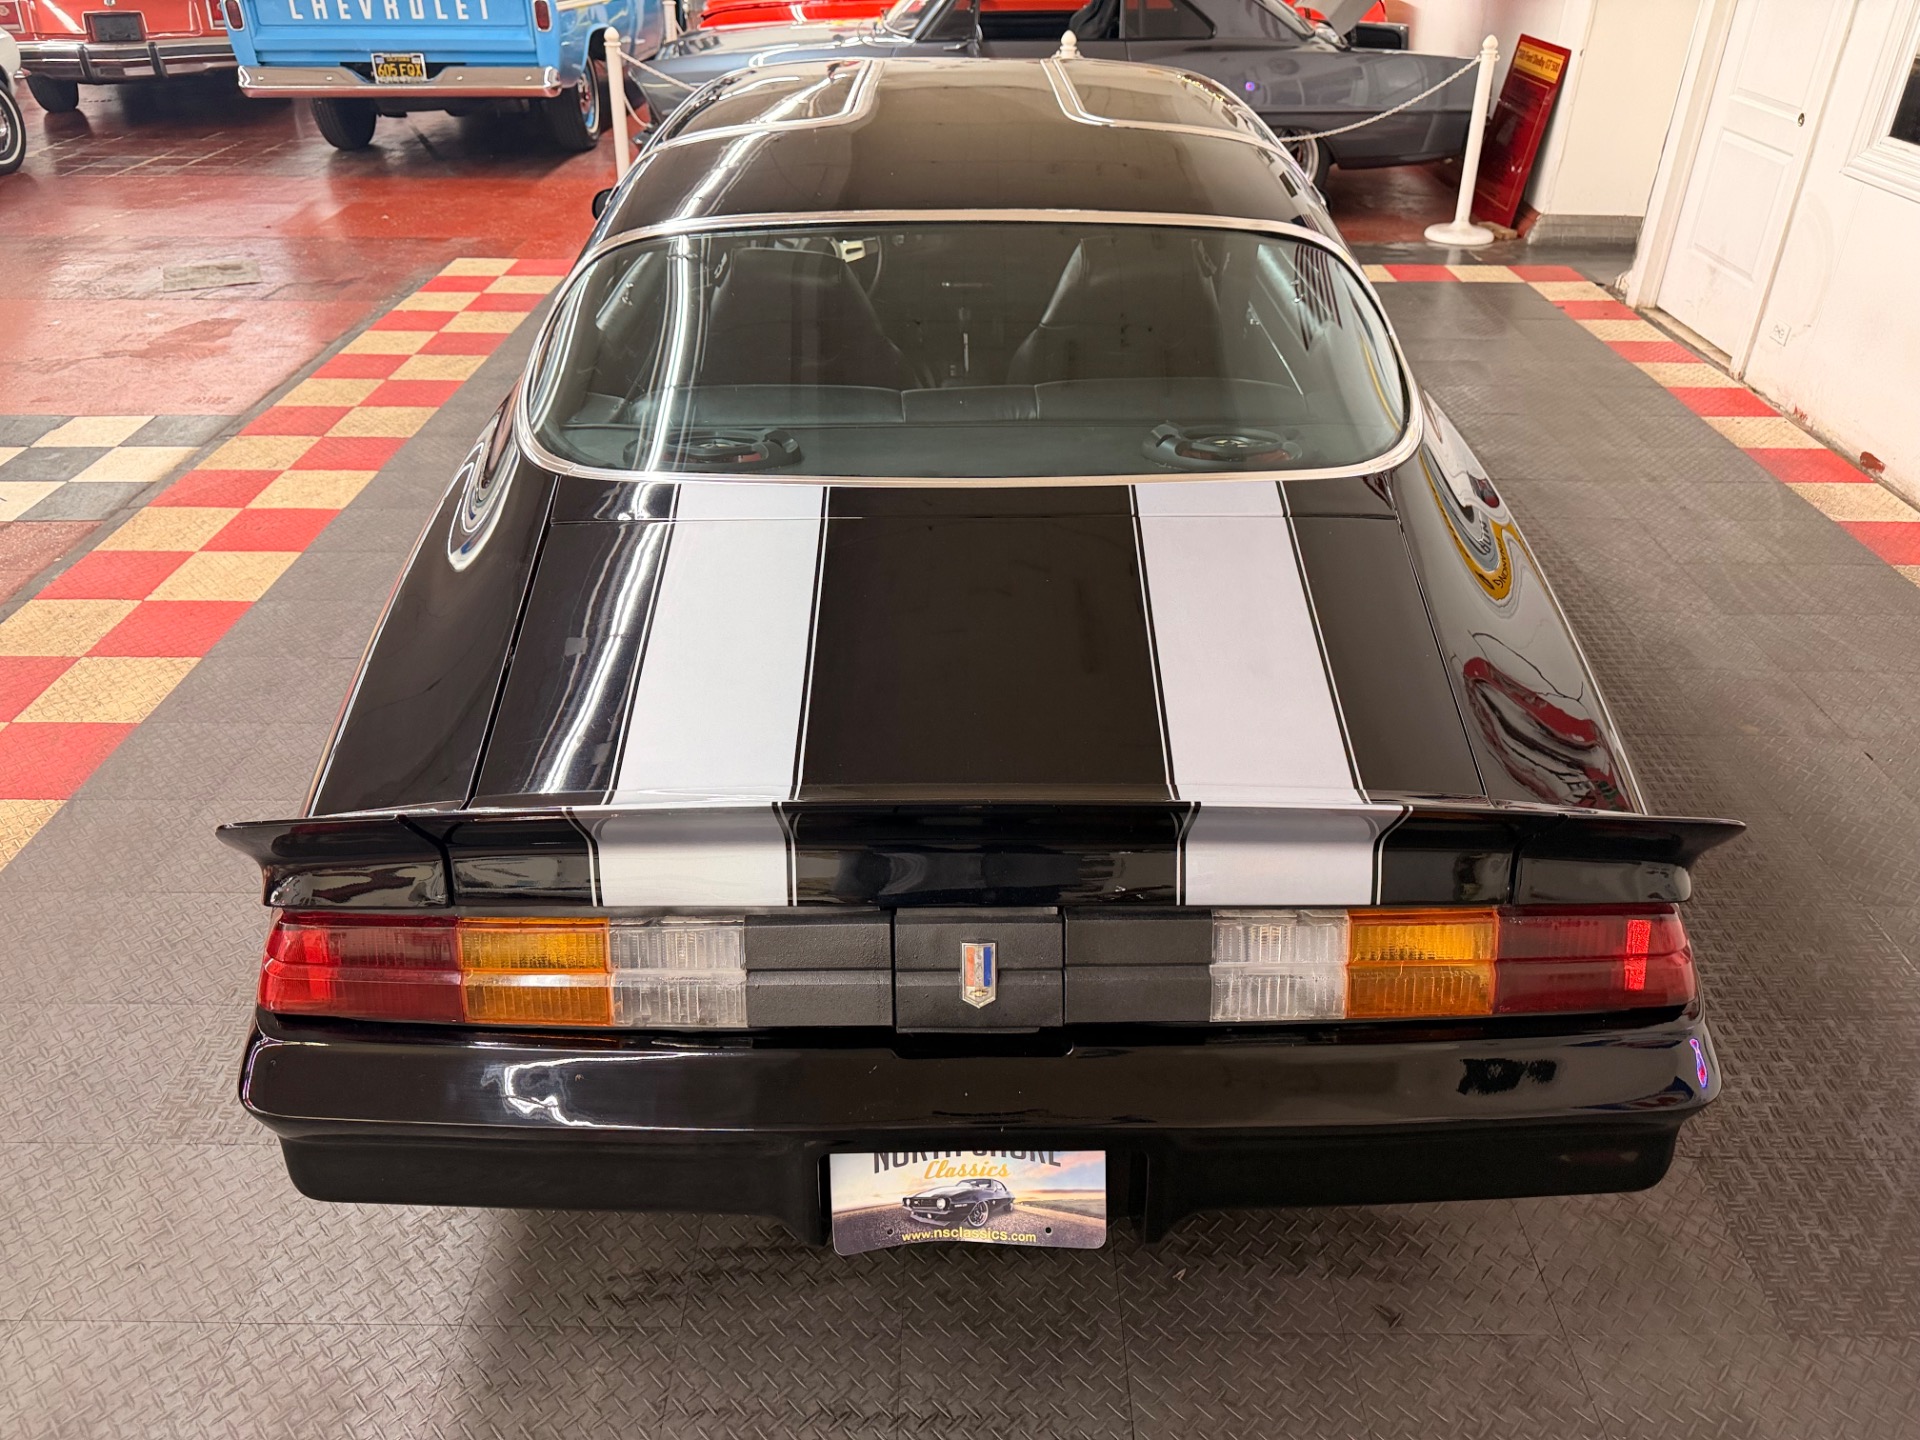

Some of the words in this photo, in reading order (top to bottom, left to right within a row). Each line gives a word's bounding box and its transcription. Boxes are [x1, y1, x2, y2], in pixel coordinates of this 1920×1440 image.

[288, 0, 488, 20] CHEVROLET
[377, 63, 398, 77] 605
[924, 1159, 1011, 1179] Classics
[901, 1226, 1037, 1243] www.nsclassics.com
